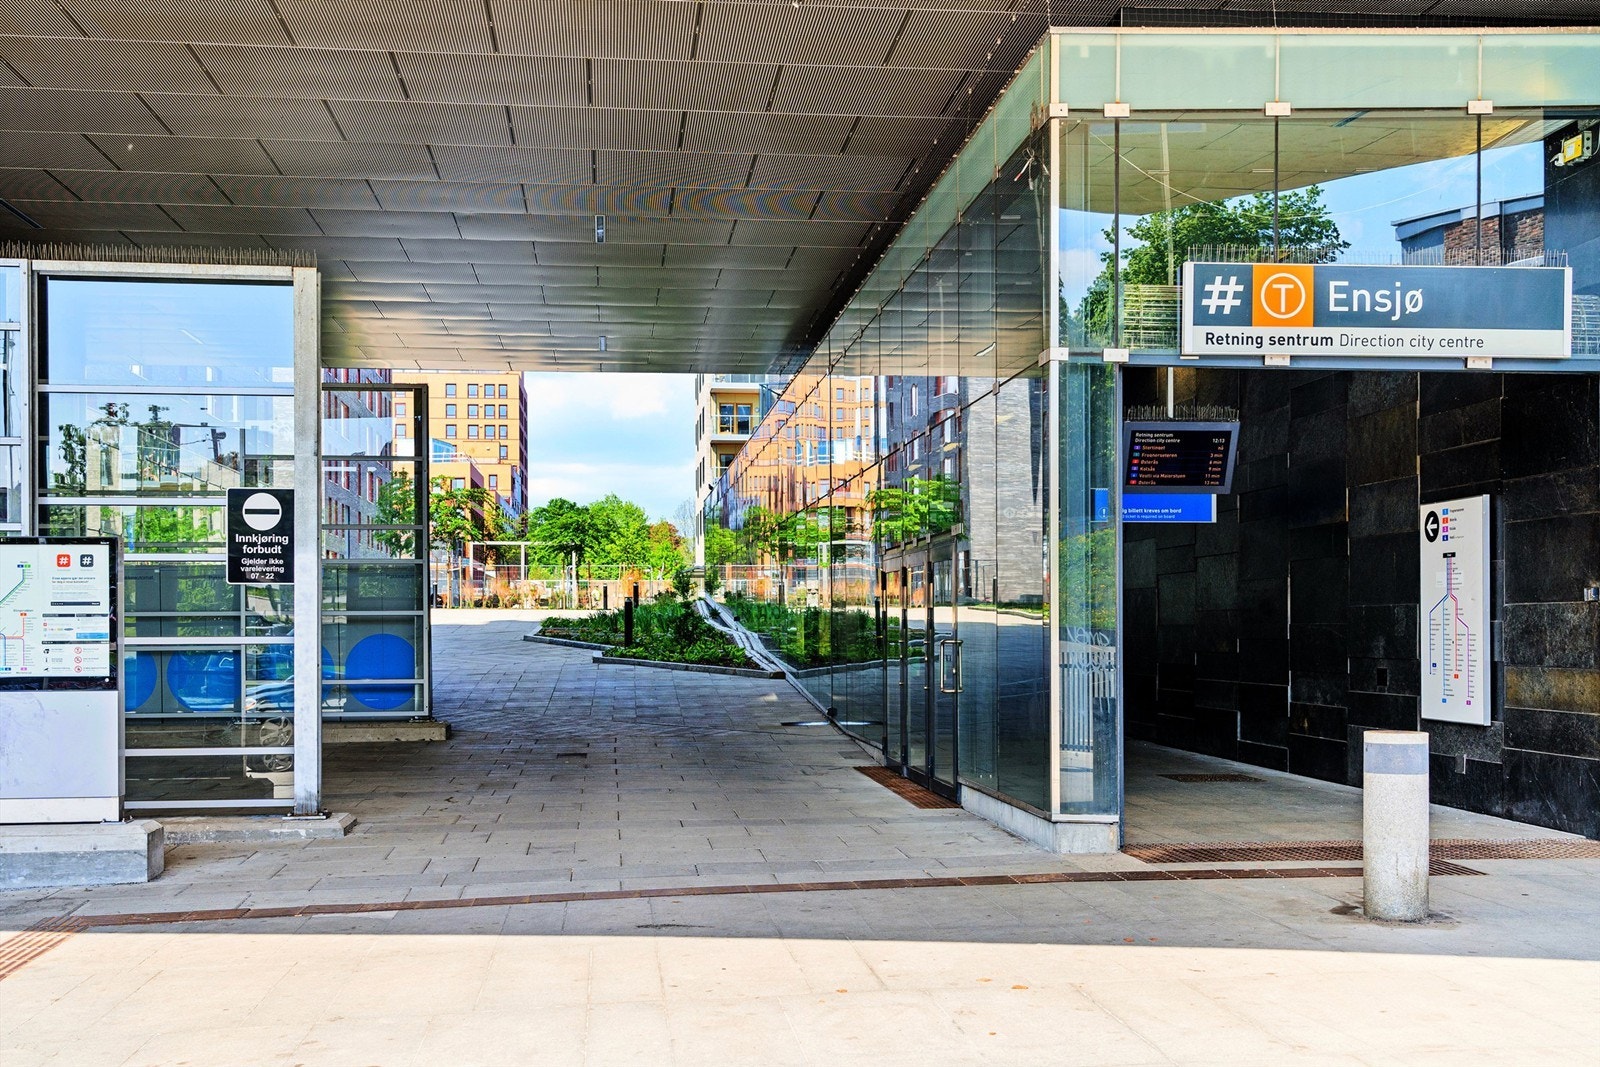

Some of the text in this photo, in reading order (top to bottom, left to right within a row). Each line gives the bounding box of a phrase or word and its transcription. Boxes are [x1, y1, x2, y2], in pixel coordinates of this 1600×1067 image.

[1329, 280, 1423, 322] Ensjø
[1205, 332, 1484, 351] Retning sentrum Direction city centre
[235, 534, 288, 544] Innkjøring
[242, 545, 282, 553] forbudt
[241, 558, 268, 566] Gjelder
